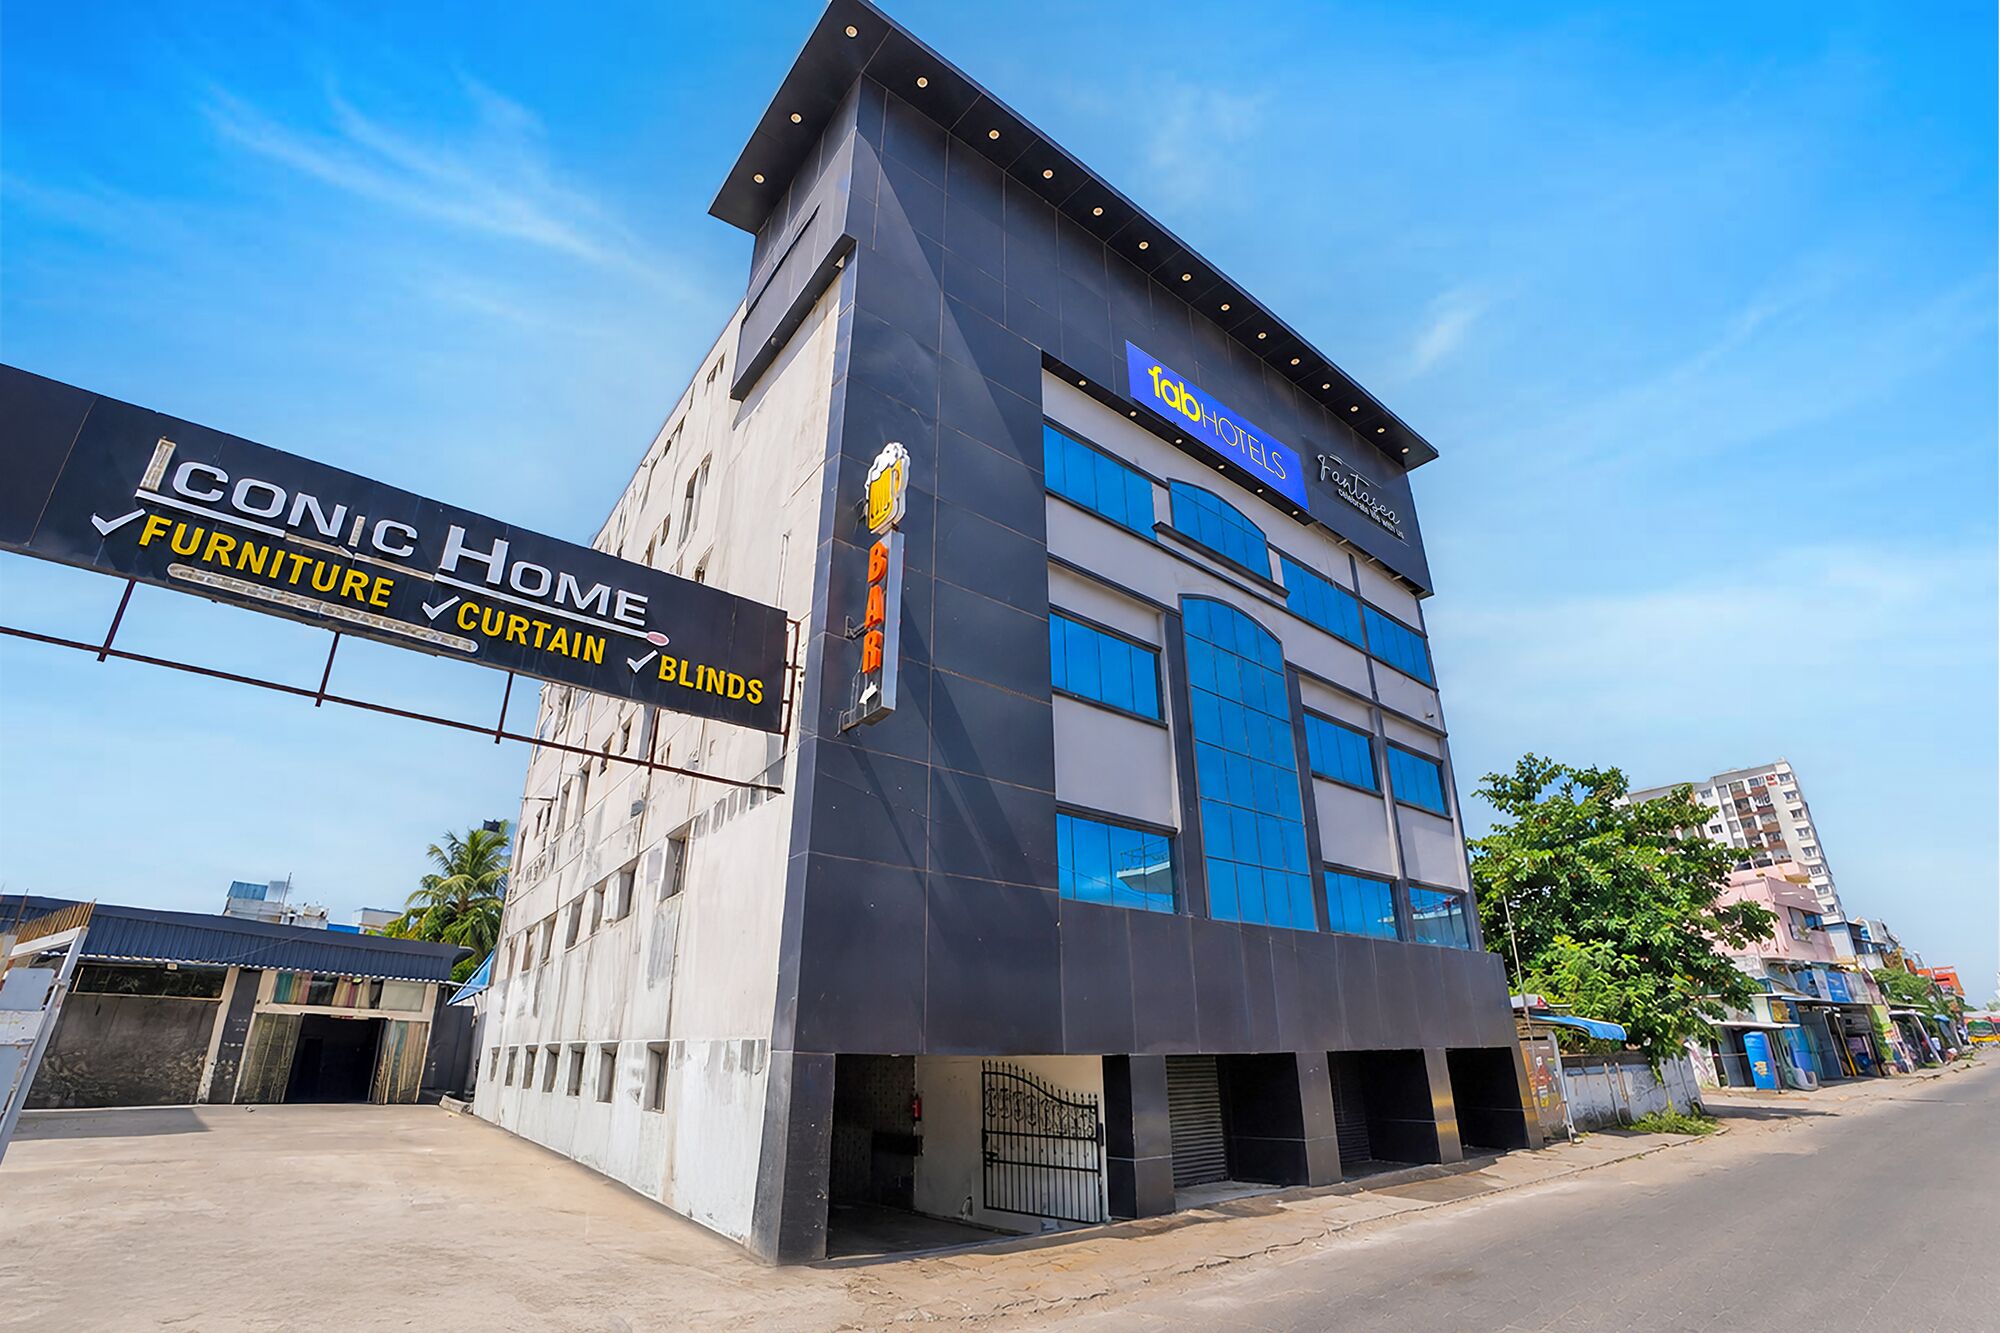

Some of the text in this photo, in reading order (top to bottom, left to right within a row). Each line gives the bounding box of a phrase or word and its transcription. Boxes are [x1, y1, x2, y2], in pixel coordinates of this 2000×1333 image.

[138, 514, 764, 705] FURNITURE CURTAIN BLINDS
[139, 438, 650, 627] ICONIC HOME
[862, 539, 889, 674] BAR
